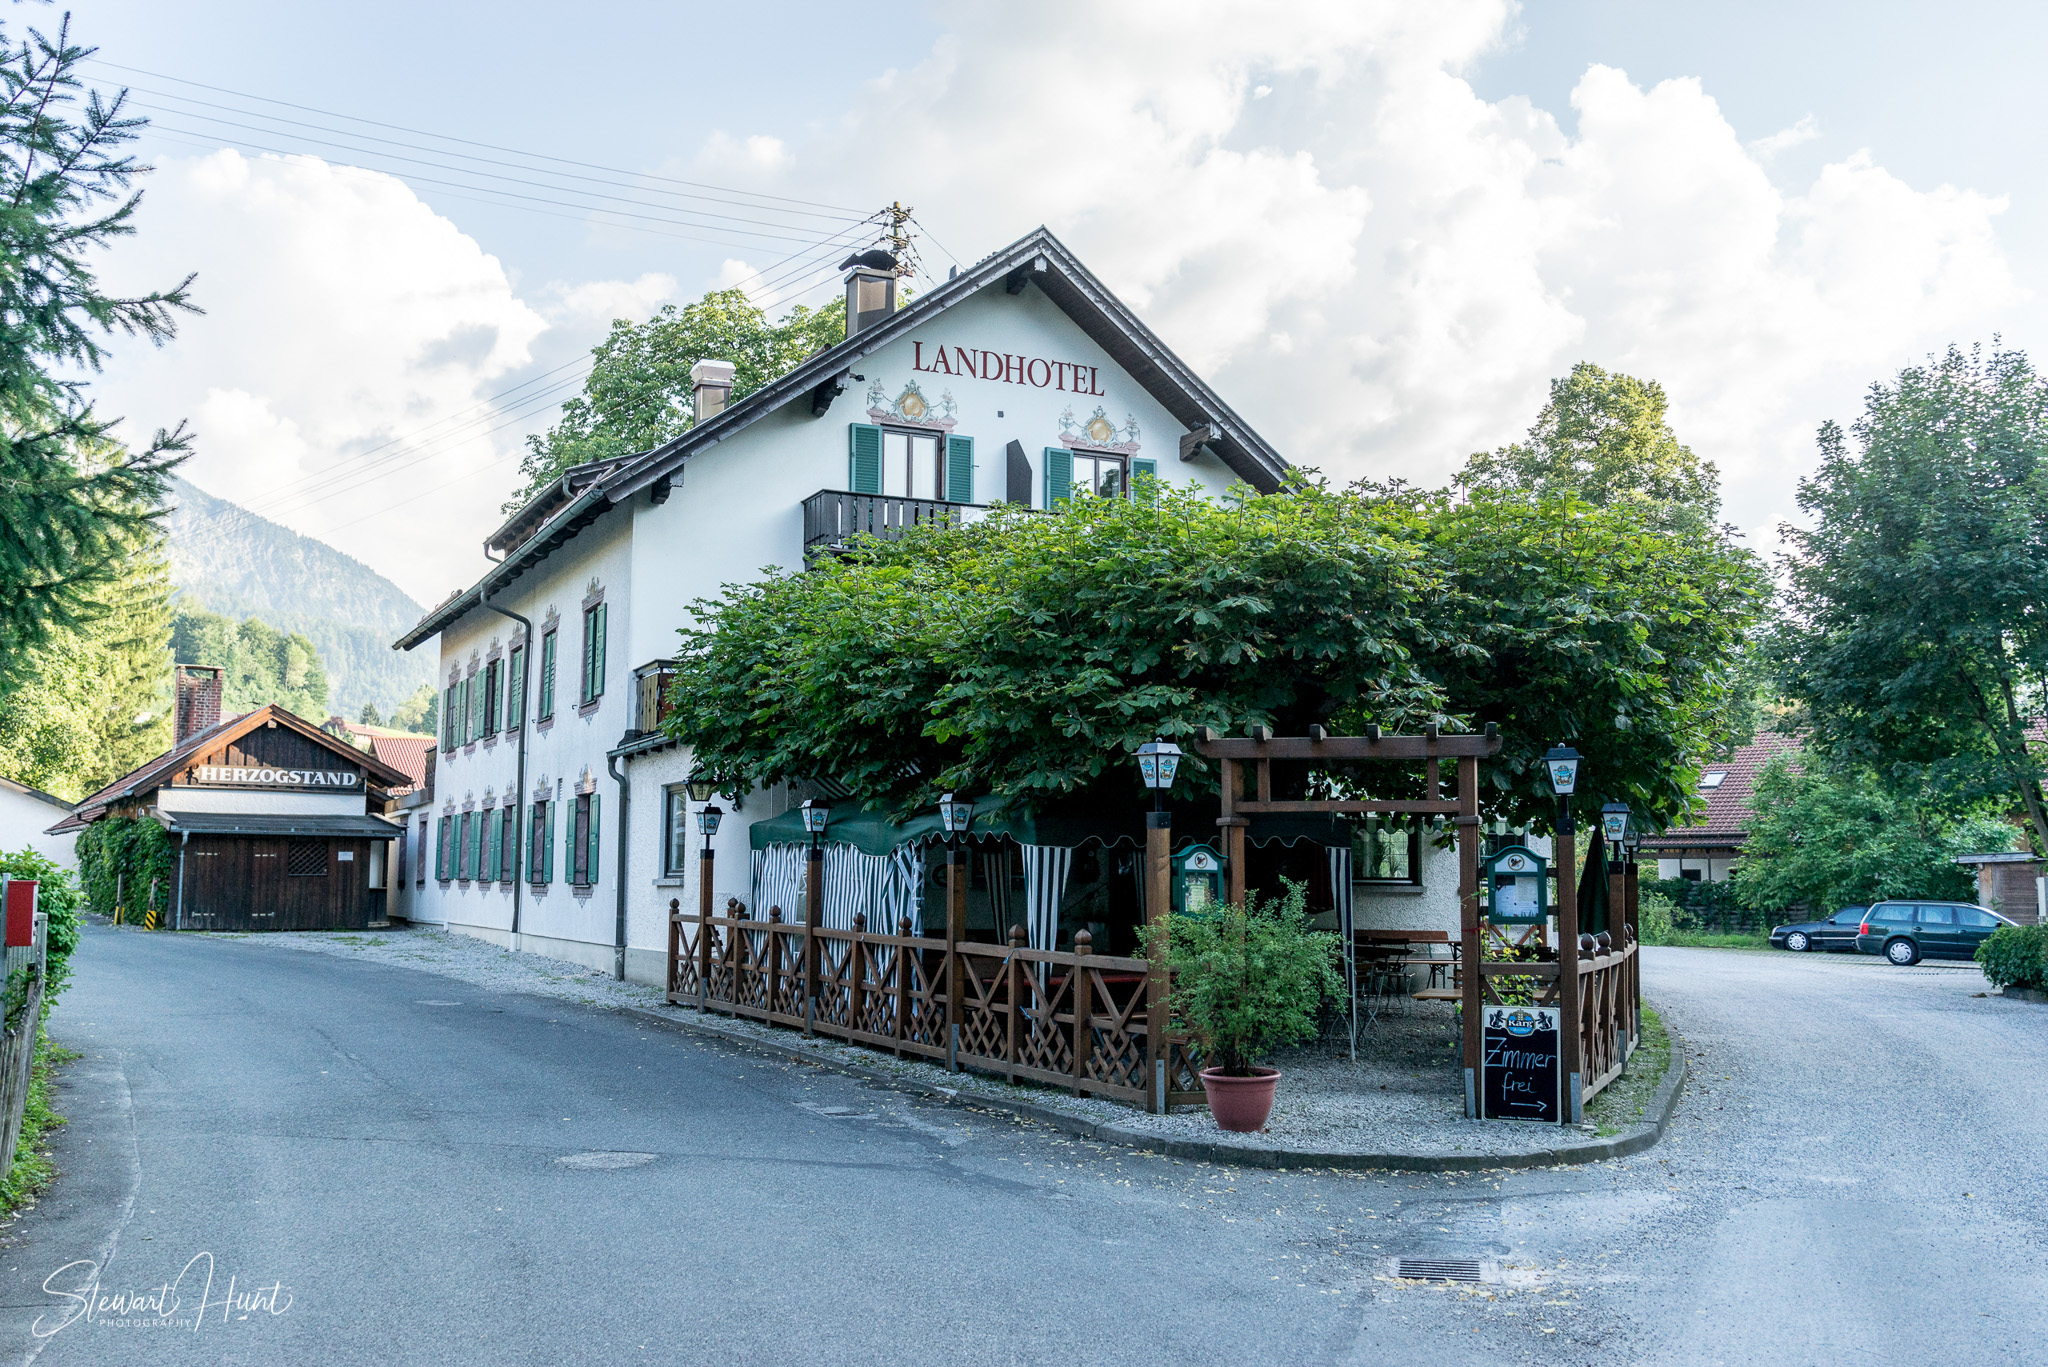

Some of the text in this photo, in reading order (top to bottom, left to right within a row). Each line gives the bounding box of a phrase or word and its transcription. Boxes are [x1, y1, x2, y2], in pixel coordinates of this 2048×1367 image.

[912, 340, 1105, 397] LANDHOTEL
[201, 766, 357, 786] HERZOGSTAND
[1508, 1019, 1534, 1028] Karg
[1484, 1036, 1557, 1070] Zimmer
[1501, 1071, 1537, 1101] frei
